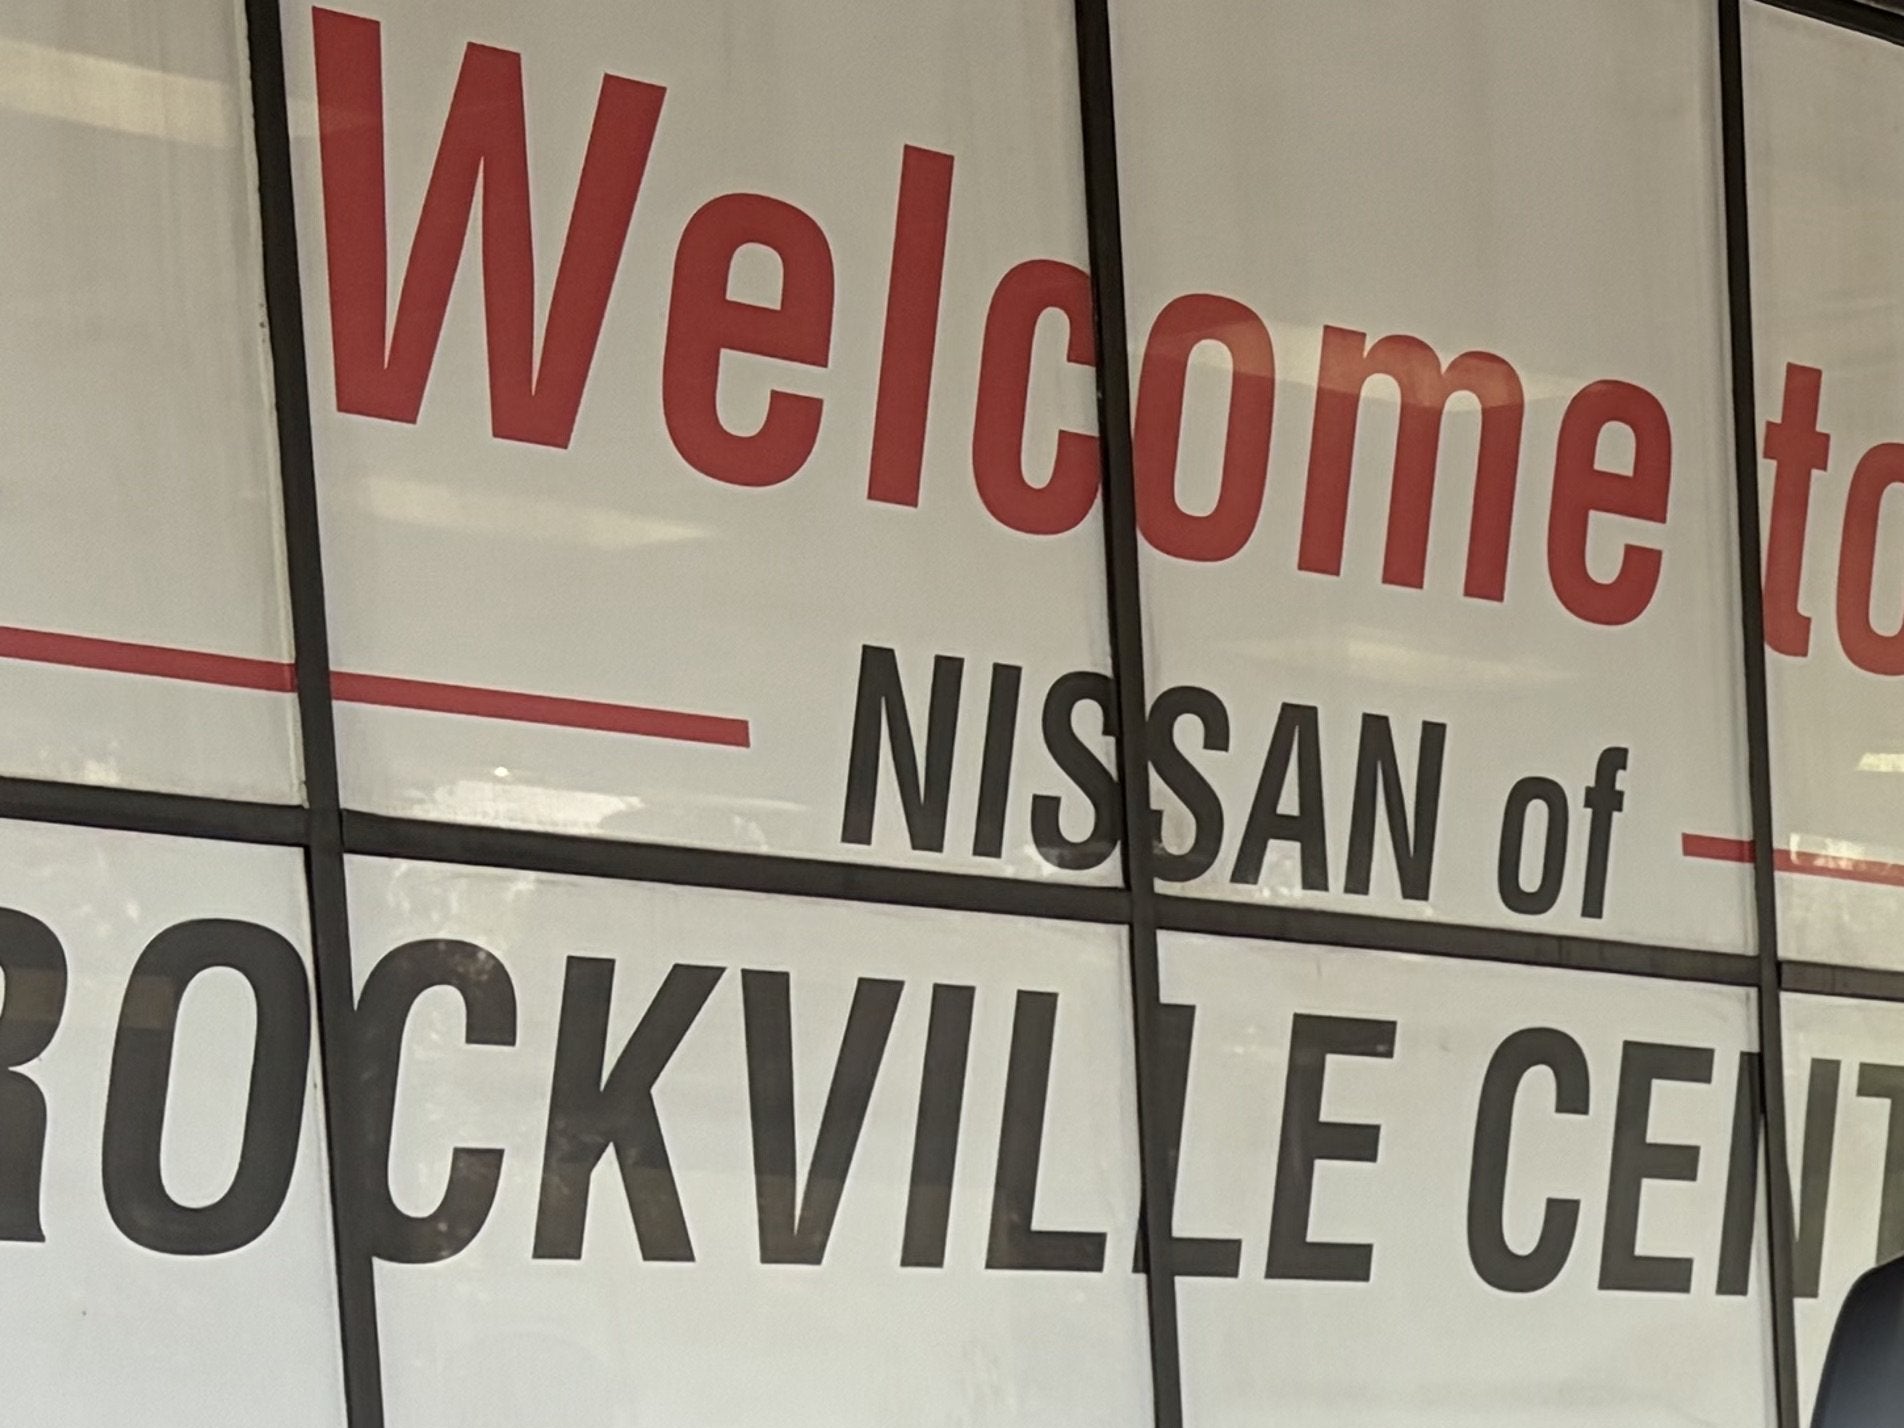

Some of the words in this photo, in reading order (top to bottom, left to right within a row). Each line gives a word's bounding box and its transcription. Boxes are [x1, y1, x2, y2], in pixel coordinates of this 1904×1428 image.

[312, 6, 1673, 626] Welcome
[840, 644, 1447, 902] NISSAN
[1497, 746, 1629, 920] of
